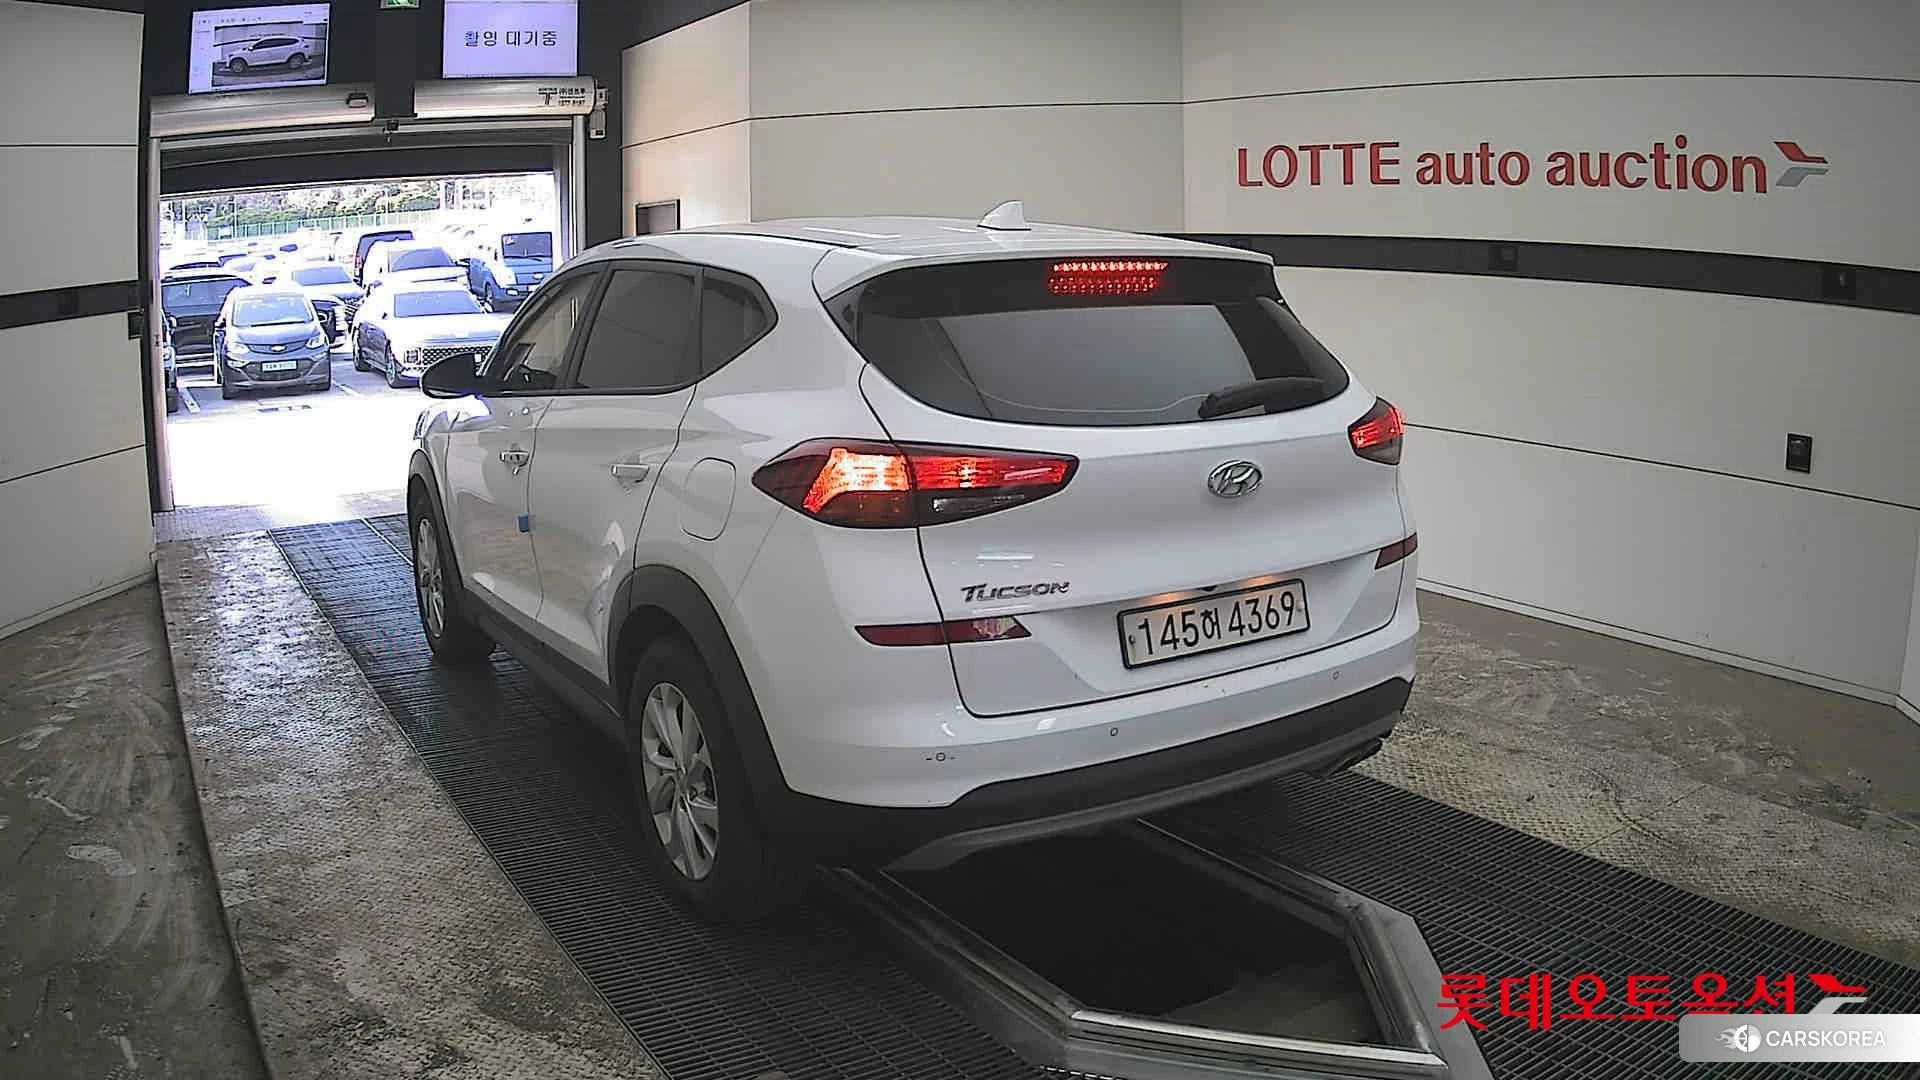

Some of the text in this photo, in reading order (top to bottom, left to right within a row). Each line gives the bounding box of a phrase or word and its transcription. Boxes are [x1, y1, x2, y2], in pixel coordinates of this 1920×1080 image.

[505, 30, 558, 47] 대기중
[1237, 134, 1767, 194] LOTTE auto auction
[960, 582, 1070, 603] TUCSON
[1228, 590, 1295, 637] 4369
